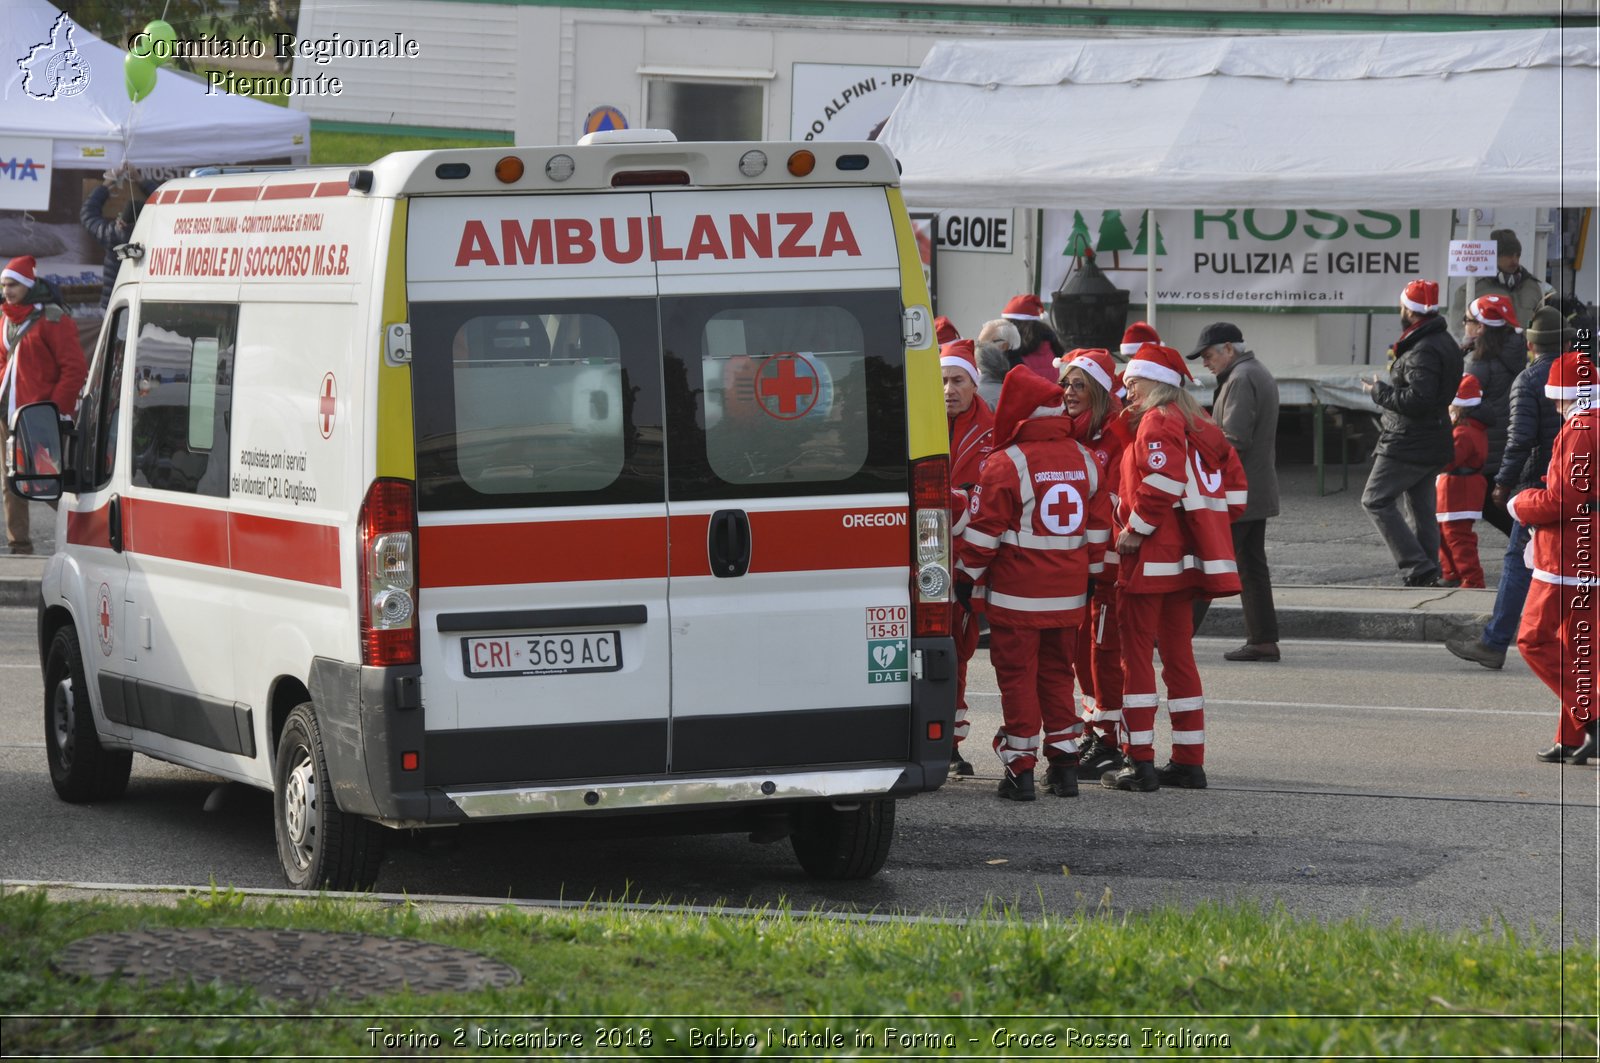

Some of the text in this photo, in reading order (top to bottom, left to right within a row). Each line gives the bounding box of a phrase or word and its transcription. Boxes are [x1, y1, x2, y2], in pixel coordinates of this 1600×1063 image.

[824, 77, 877, 121] ALPINI
[174, 217, 193, 234] CROCE
[192, 216, 212, 234] ROSSA
[211, 216, 238, 234] ITALIANA
[241, 215, 272, 233] COMITATO
[271, 214, 296, 232] LOCALE
[301, 213, 324, 231] RIVOLI
[1194, 209, 1420, 241] ROSSI
[454, 211, 863, 267] AMBULANZA
[149, 240, 350, 277] UNITÀ MOBILE DI SOCCORSO M.S.B.
[1194, 251, 1421, 274] PULIZIA E IGIENE
[240, 446, 270, 470] acquistata
[270, 453, 283, 470] con
[285, 451, 307, 472] servizi
[1034, 470, 1086, 483] CROCE ROSSA ITALIANA
[231, 472, 317, 506] dei volontari C.R.I. Grugliasco
[842, 512, 907, 528] OREGON
[867, 606, 907, 622] TO10
[869, 623, 906, 638] 15-81
[474, 641, 511, 669] CRI
[875, 671, 902, 683] DAE
